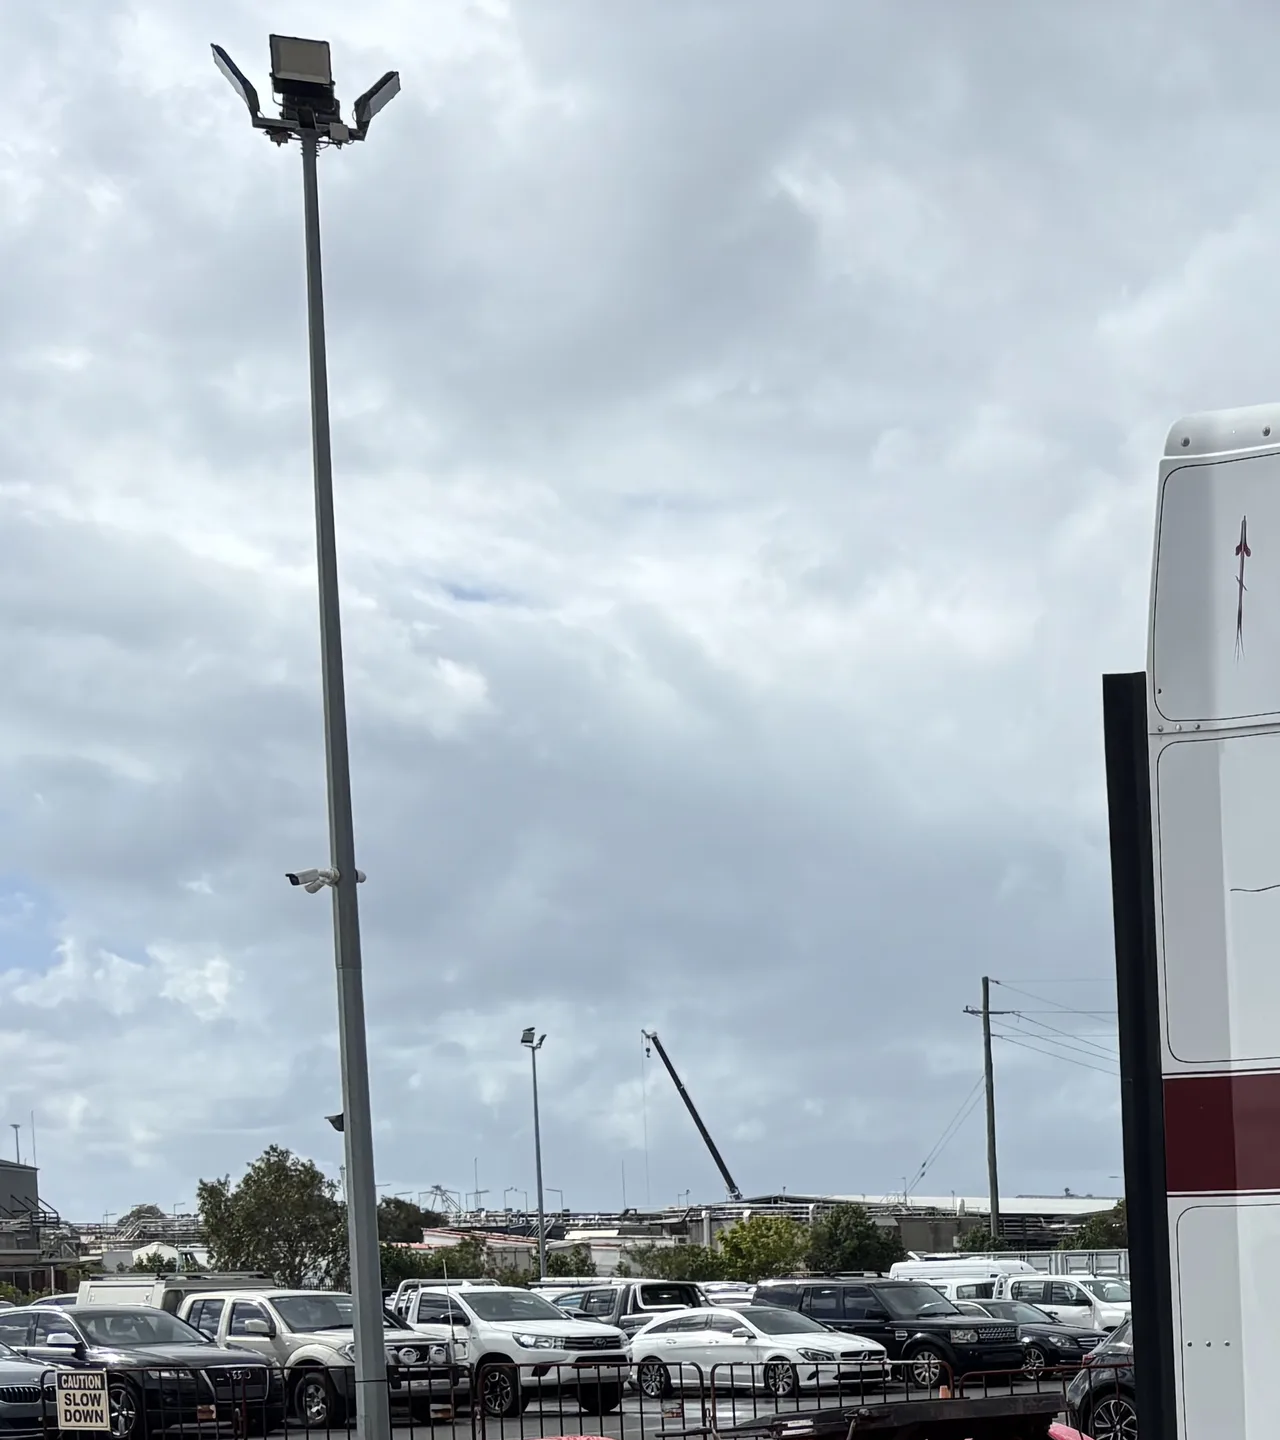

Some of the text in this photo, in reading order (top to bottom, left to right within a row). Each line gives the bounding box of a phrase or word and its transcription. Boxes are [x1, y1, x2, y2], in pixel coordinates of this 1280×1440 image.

[61, 1374, 102, 1389] CAUTION
[64, 1393, 102, 1407] SLOW
[64, 1408, 104, 1423] DOWN
